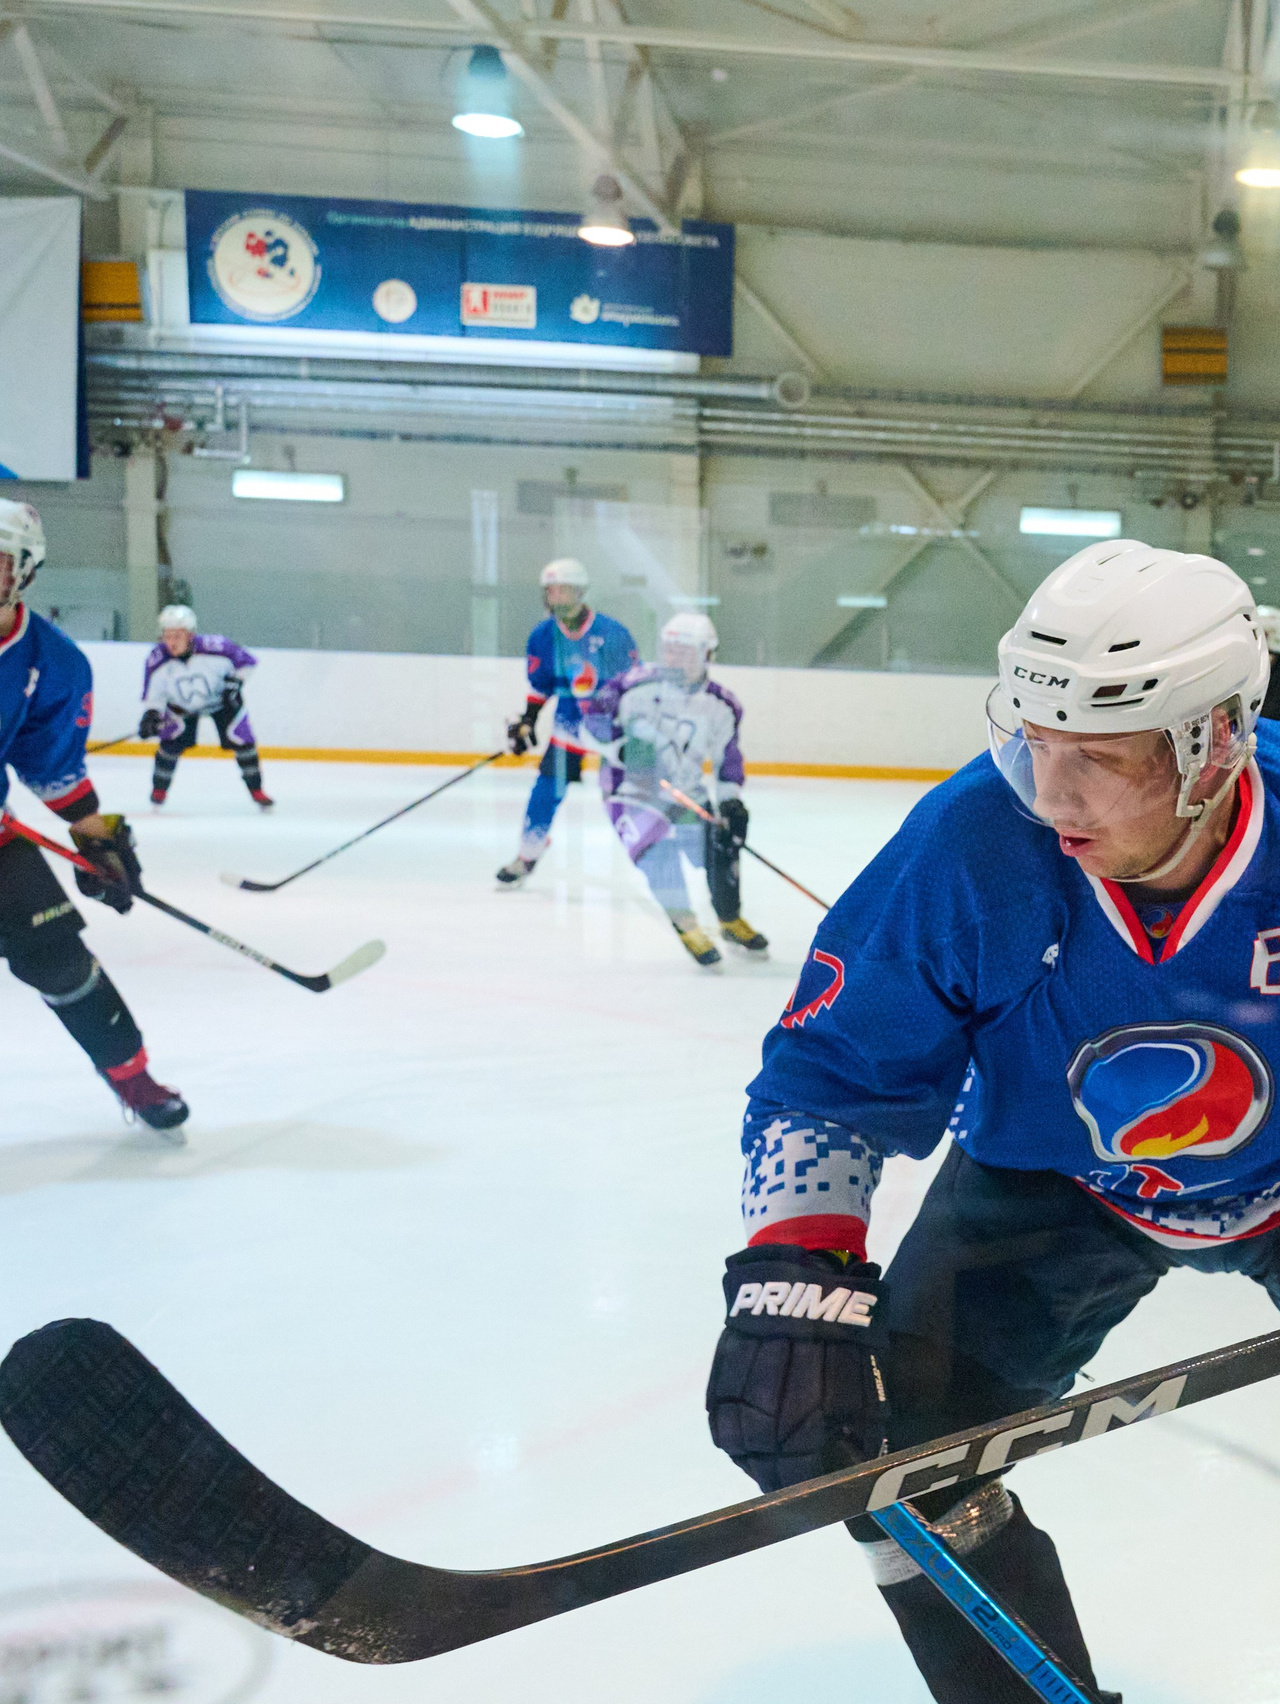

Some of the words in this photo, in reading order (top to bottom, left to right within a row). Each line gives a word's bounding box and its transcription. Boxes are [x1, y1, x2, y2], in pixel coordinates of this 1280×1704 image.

[1013, 665, 1070, 689] CCM
[781, 949, 845, 1029] 7
[729, 1281, 878, 1328] PRIME
[866, 1374, 1188, 1512] CCM
